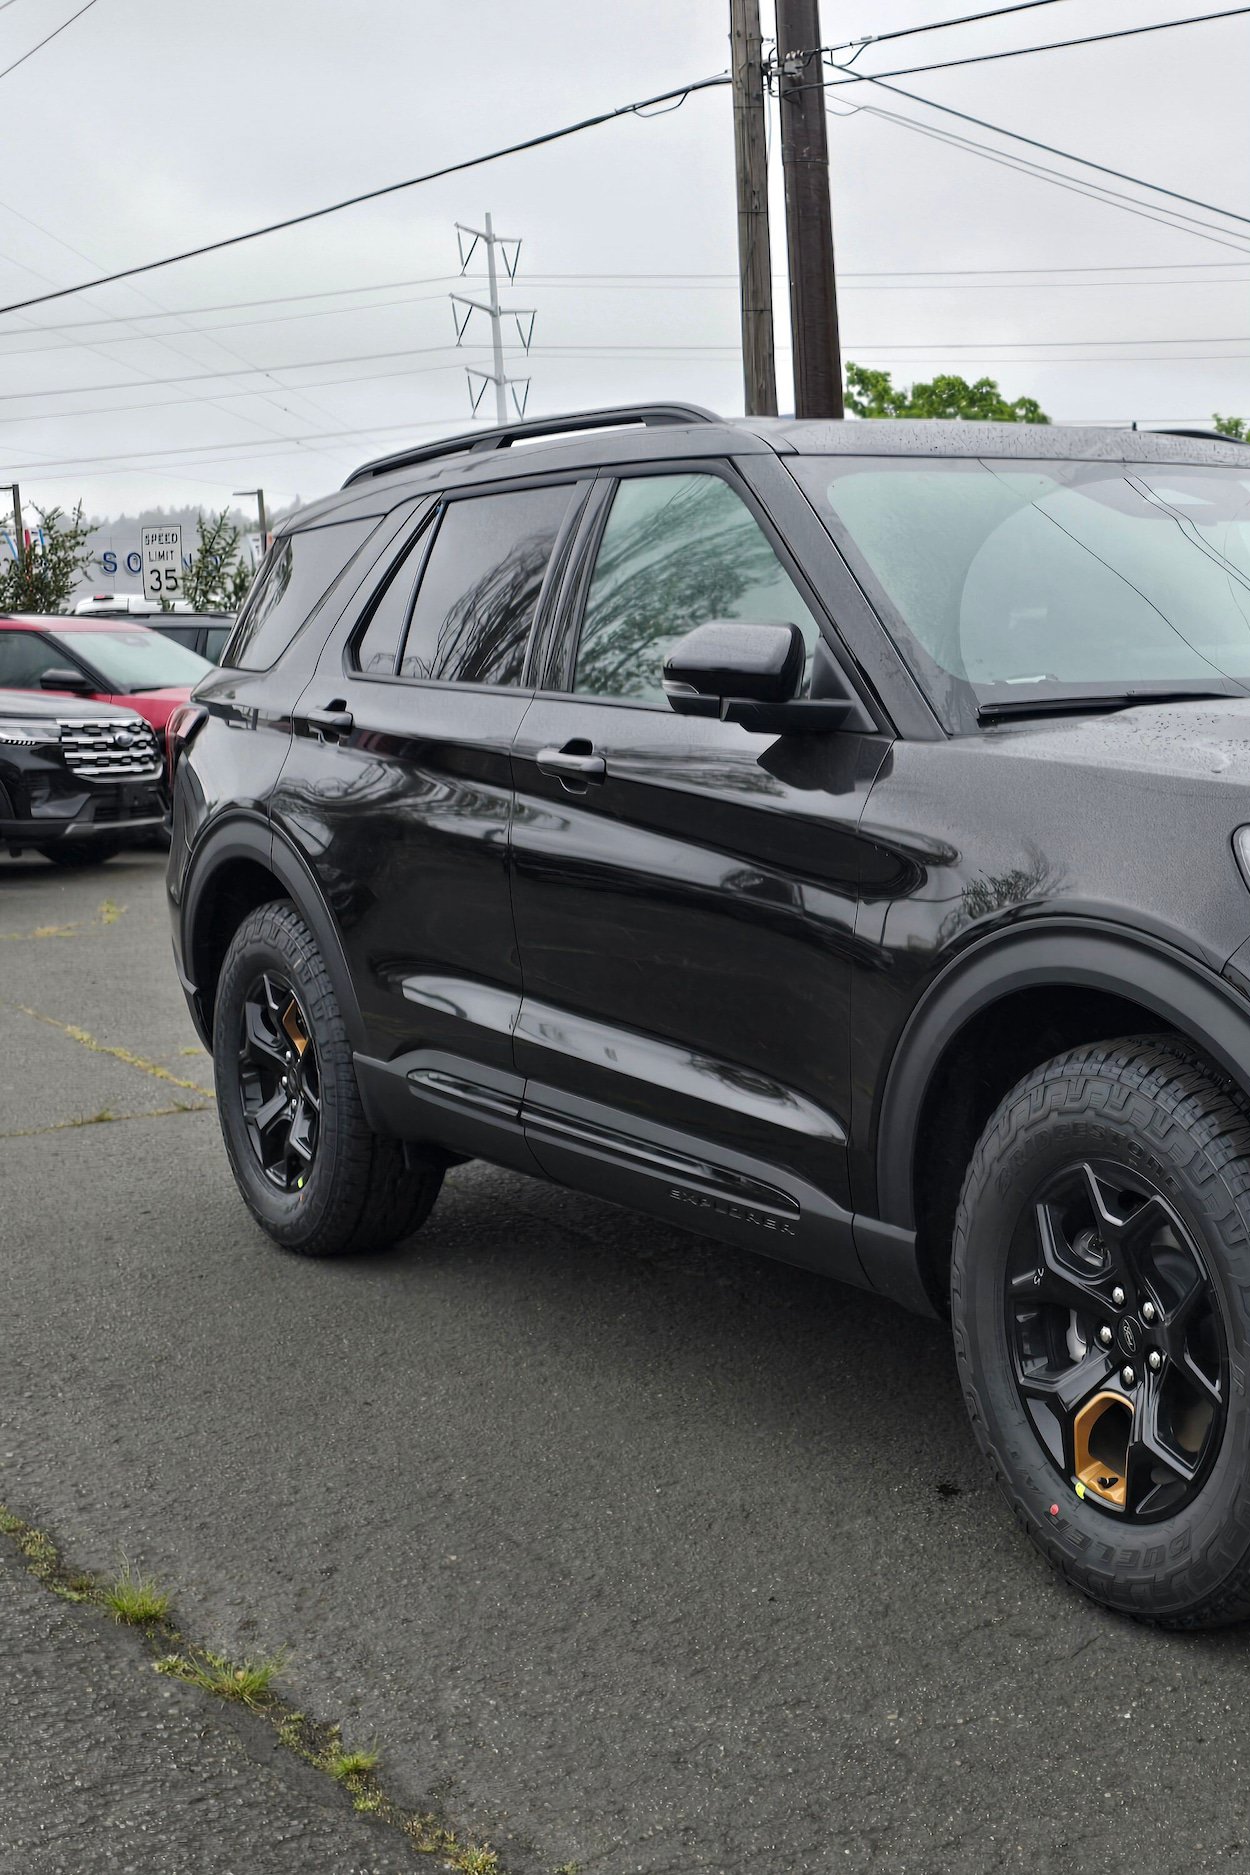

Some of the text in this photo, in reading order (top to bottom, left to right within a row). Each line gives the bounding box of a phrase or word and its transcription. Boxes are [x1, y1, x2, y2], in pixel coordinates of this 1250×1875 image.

[145, 533, 178, 545] SPEED
[149, 550, 174, 562] LIMIT
[150, 568, 178, 592] 35
[669, 1189, 796, 1236] EXPLORER
